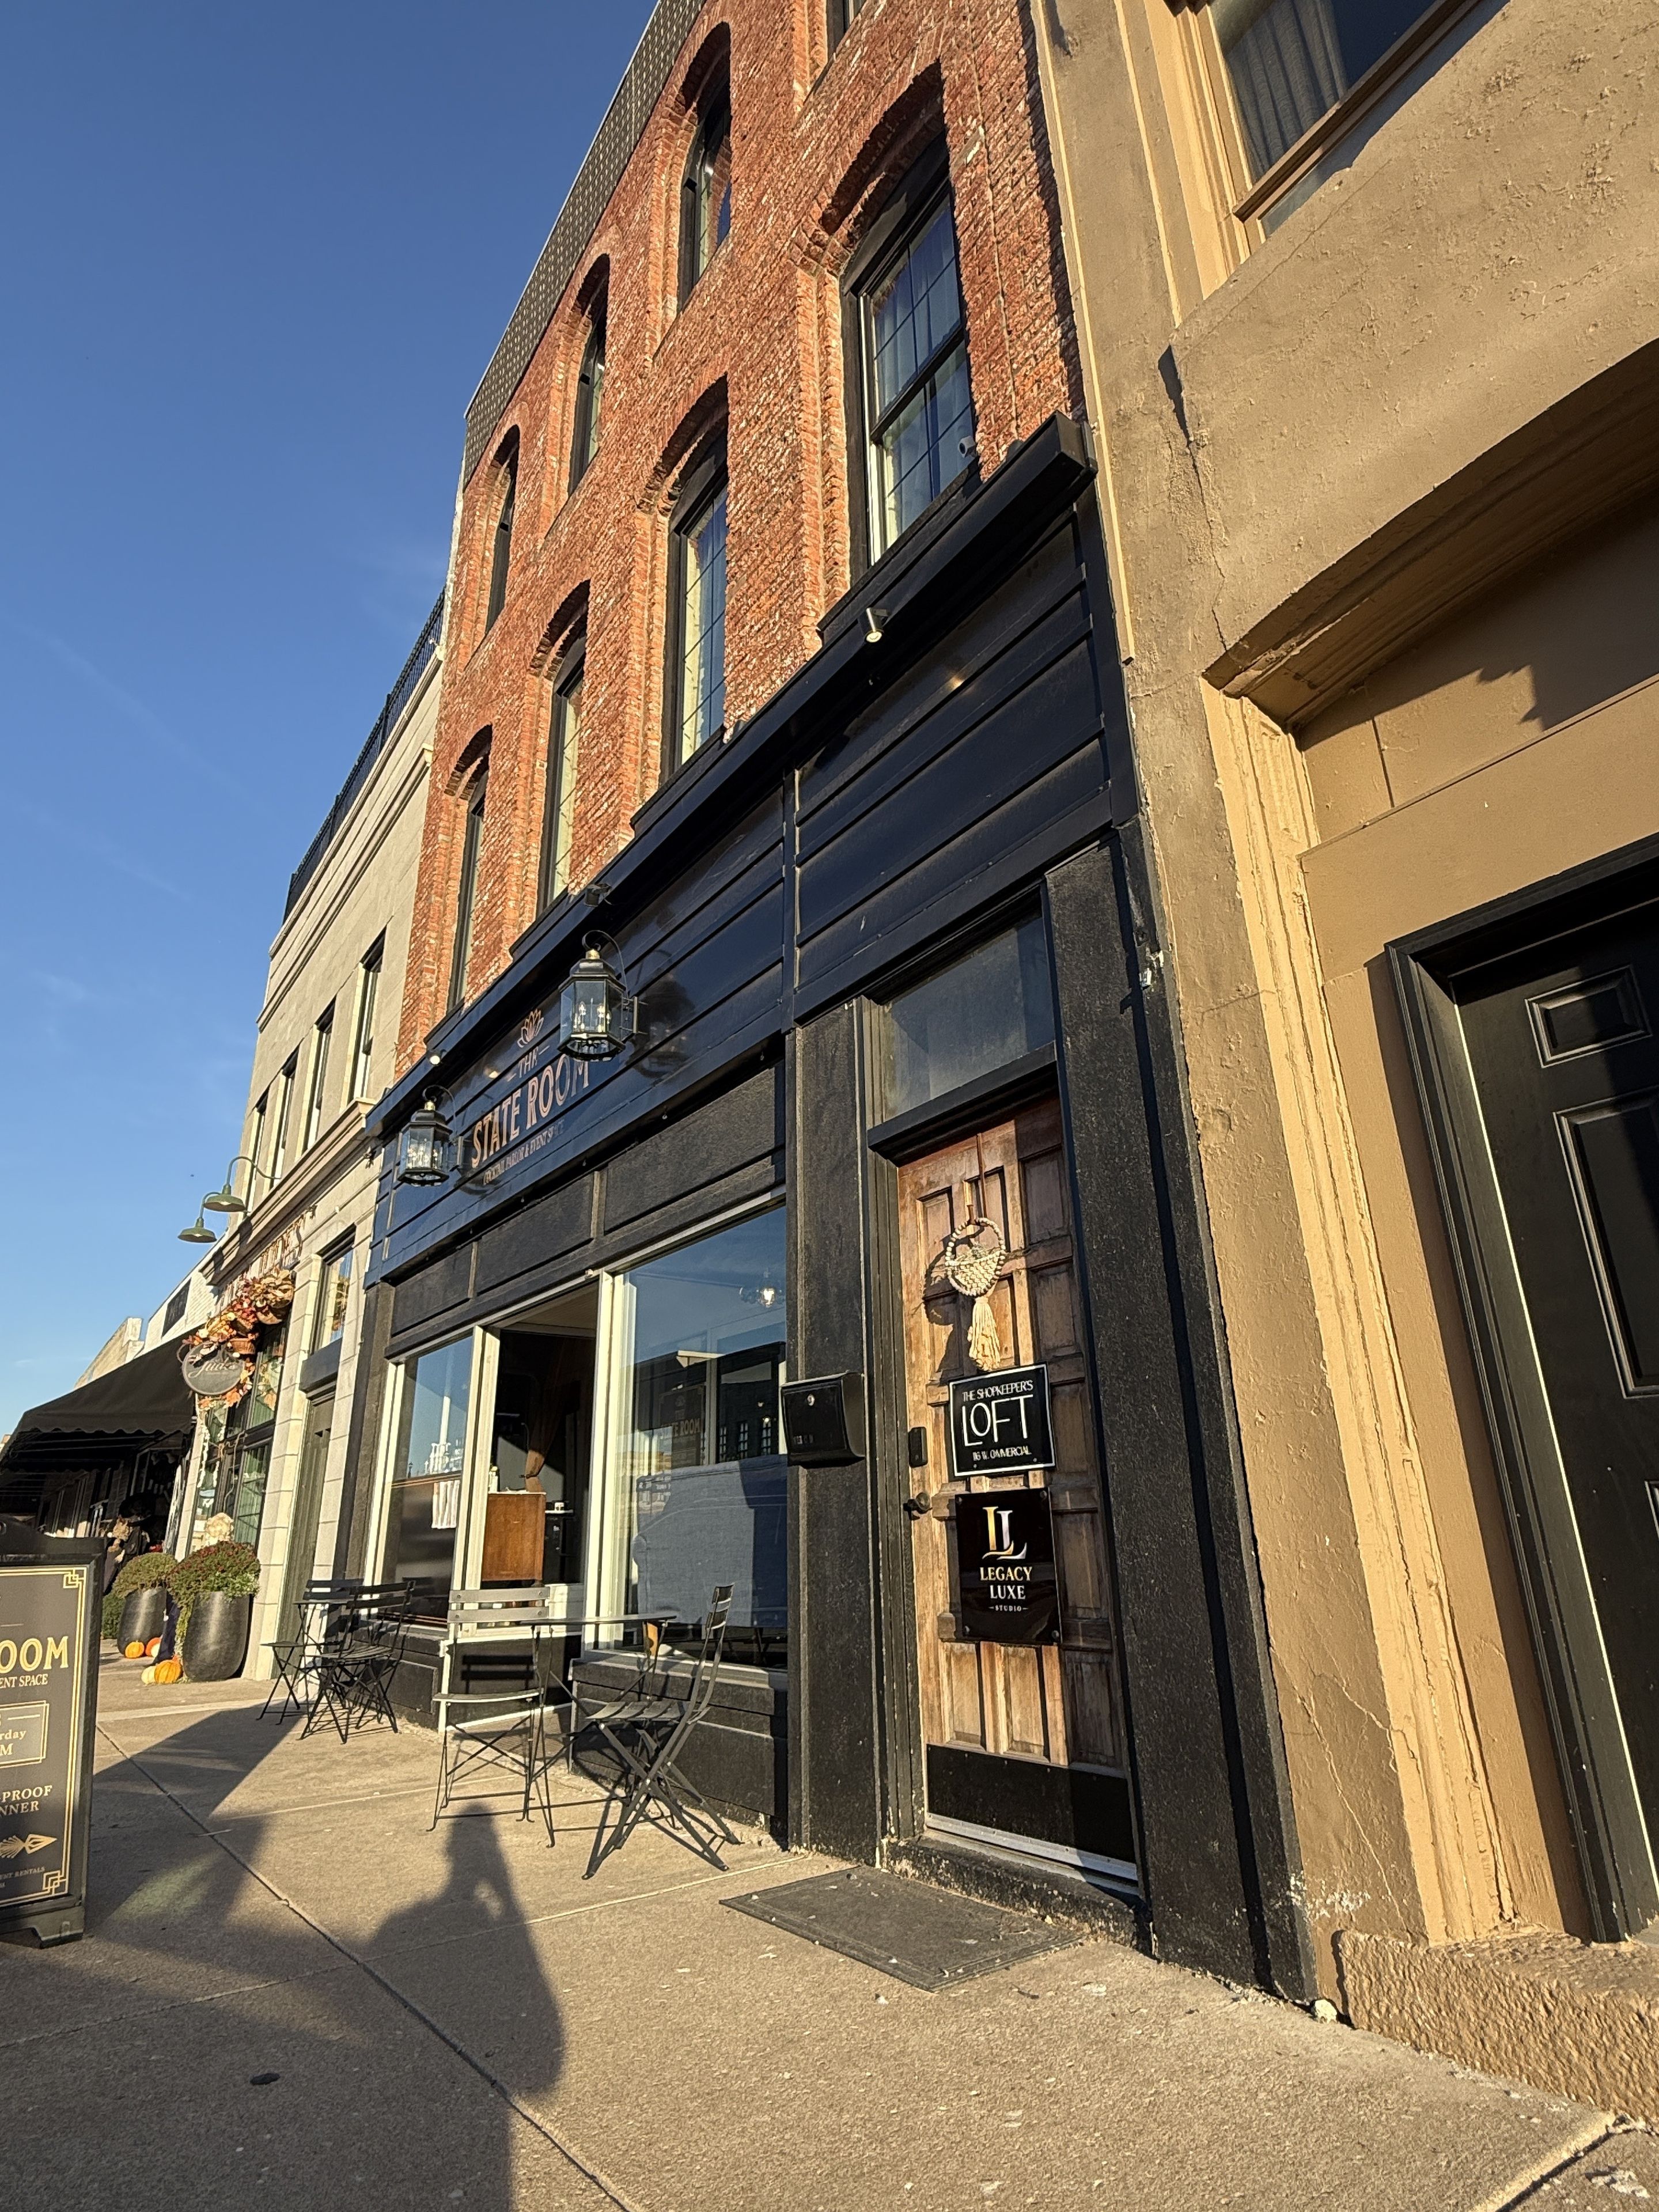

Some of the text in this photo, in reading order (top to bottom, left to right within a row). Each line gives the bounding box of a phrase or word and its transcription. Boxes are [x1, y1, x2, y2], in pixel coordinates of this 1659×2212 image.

[472, 1054, 589, 1168] STATE ROOM
[962, 1380, 1033, 1402] THE SHOPKEEPER'S
[962, 1394, 1033, 1446] LOFT
[980, 1566, 1032, 1581] LEGACY
[990, 1585, 1026, 1600] LUXE
[19, 1673, 48, 1687] SPACE
